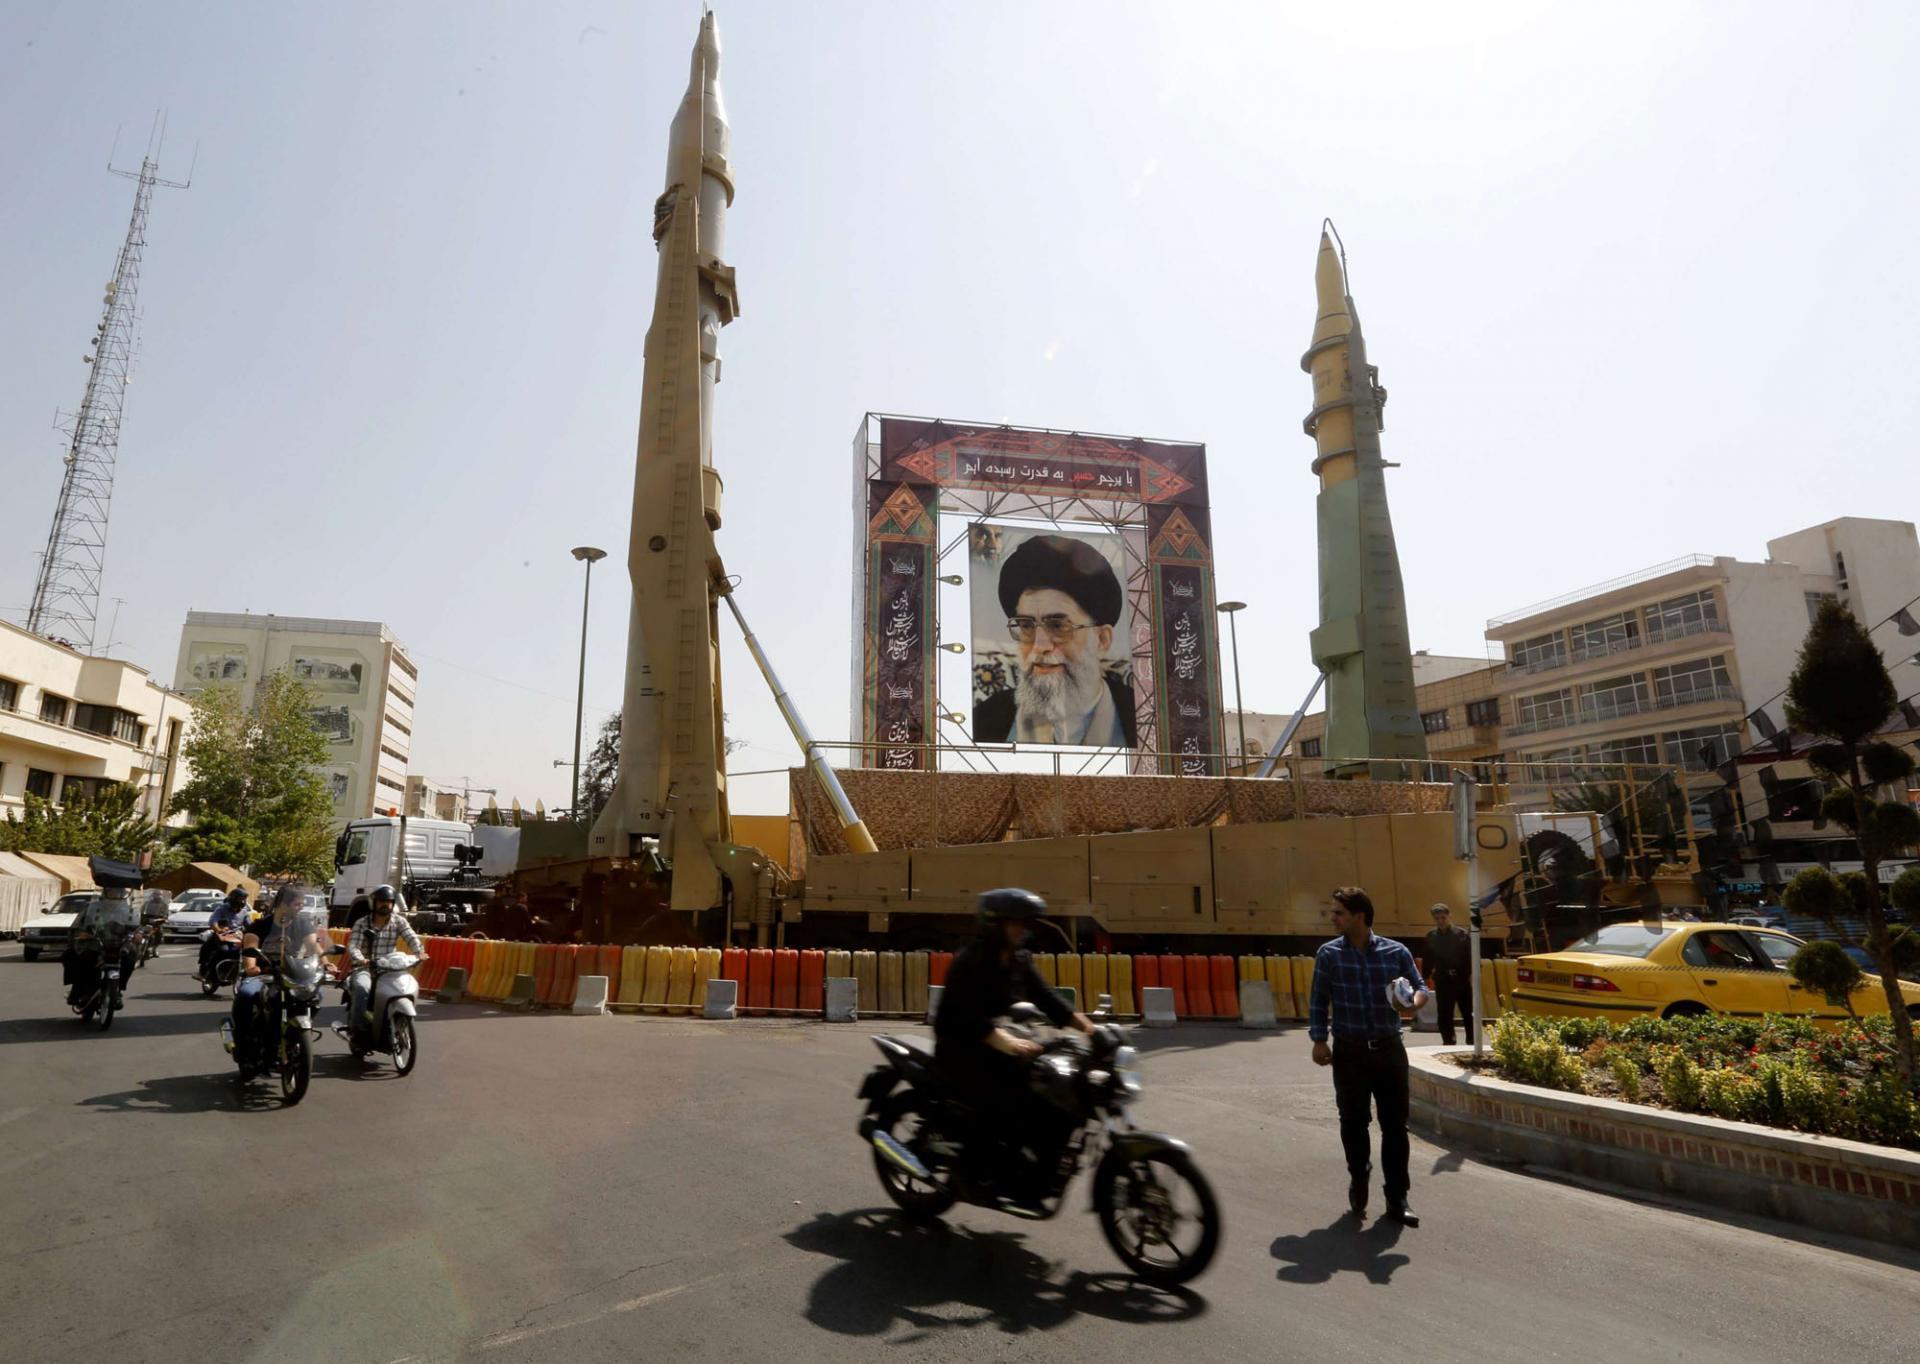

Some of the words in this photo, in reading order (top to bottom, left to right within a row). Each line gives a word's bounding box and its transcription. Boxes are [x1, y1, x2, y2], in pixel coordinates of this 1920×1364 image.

[985, 464, 1016, 479] رسیده
[1020, 465, 1049, 480] قدرت
[1052, 470, 1064, 482] به
[1125, 469, 1133, 487] با
